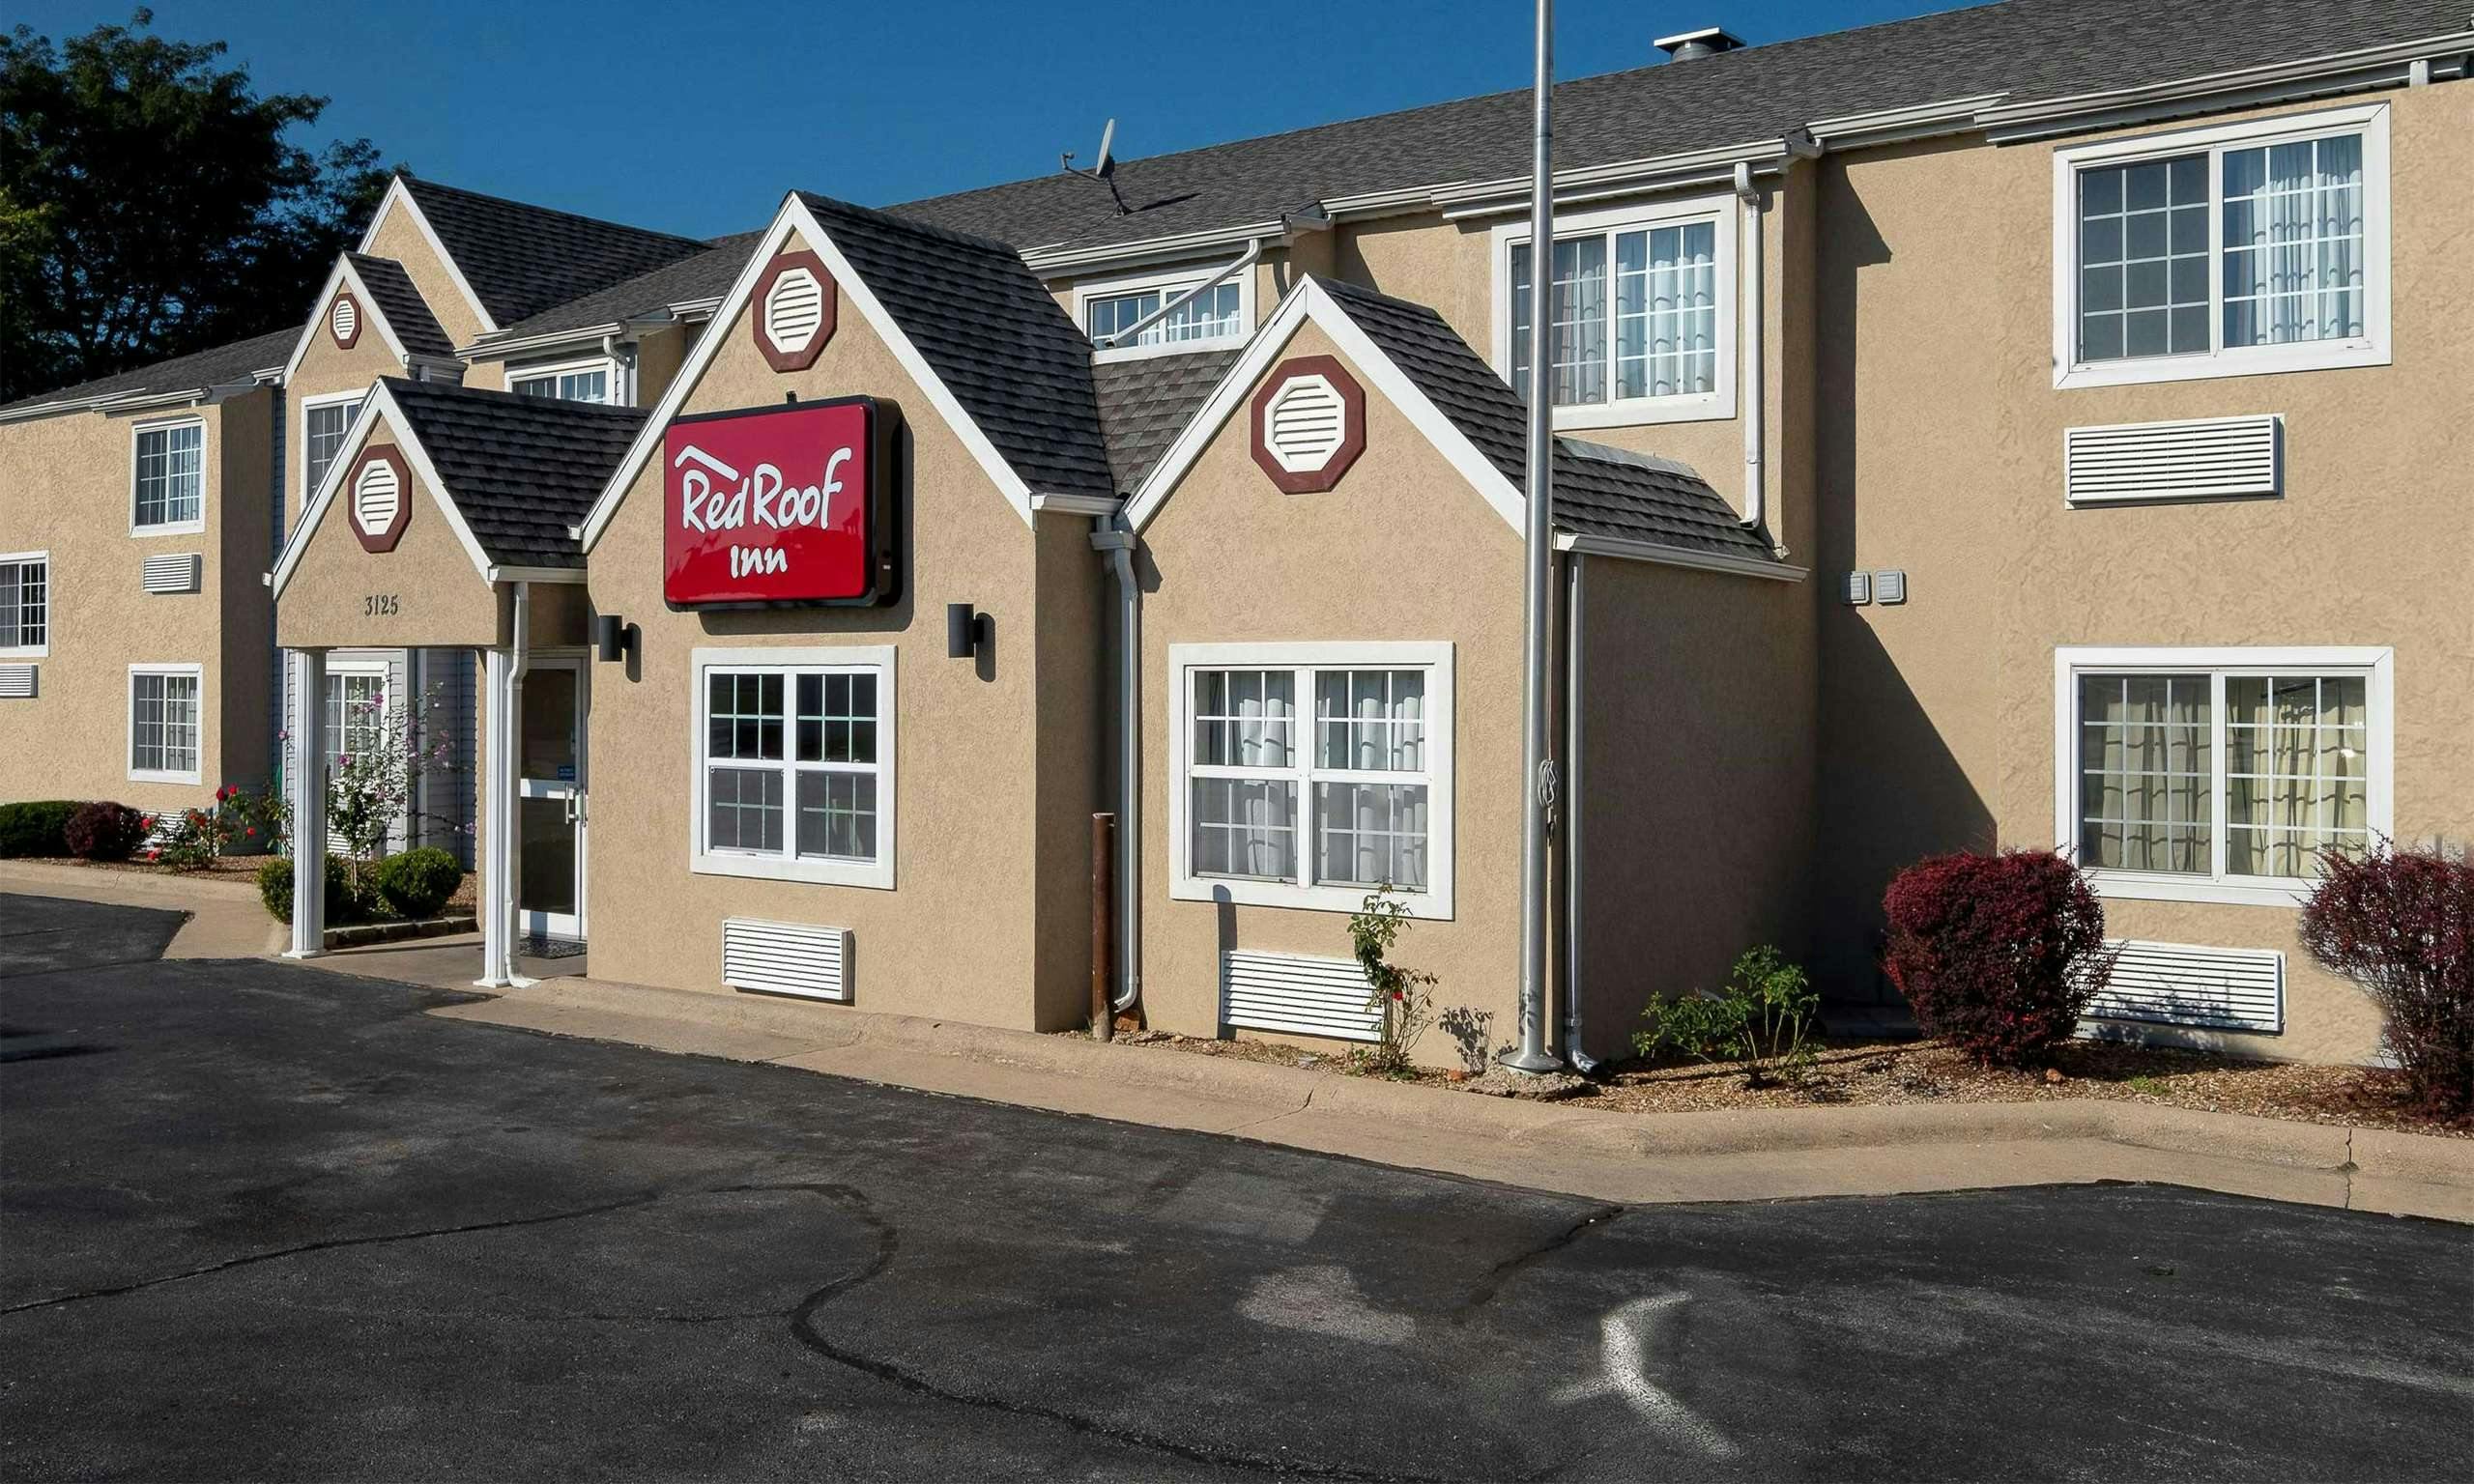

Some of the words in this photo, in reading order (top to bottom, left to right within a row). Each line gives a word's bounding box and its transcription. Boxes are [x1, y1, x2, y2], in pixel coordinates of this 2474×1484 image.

[682, 469, 751, 533] Red
[753, 447, 852, 529] Roof
[730, 545, 789, 579] Inn
[364, 594, 398, 616] 3125
